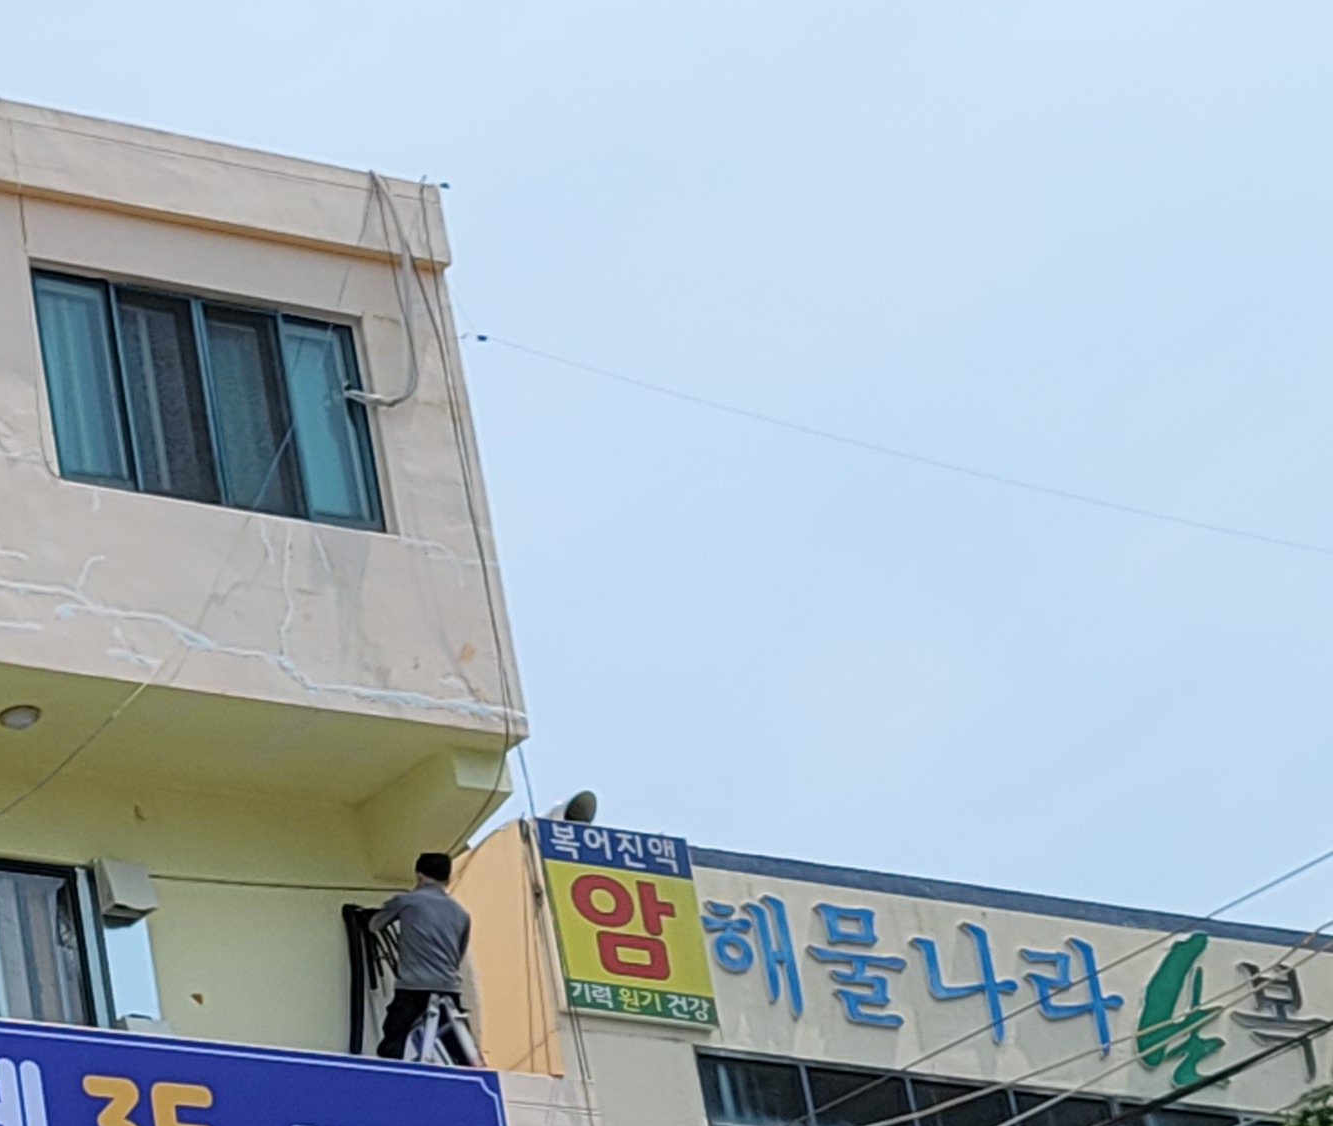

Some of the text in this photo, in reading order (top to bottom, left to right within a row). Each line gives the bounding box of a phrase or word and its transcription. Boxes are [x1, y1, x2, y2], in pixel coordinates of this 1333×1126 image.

[550, 822, 680, 875] 복어진액
[570, 874, 676, 981] 암
[569, 982, 711, 1022] 기력 원기 건강
[701, 893, 1125, 1057] 해물나라
